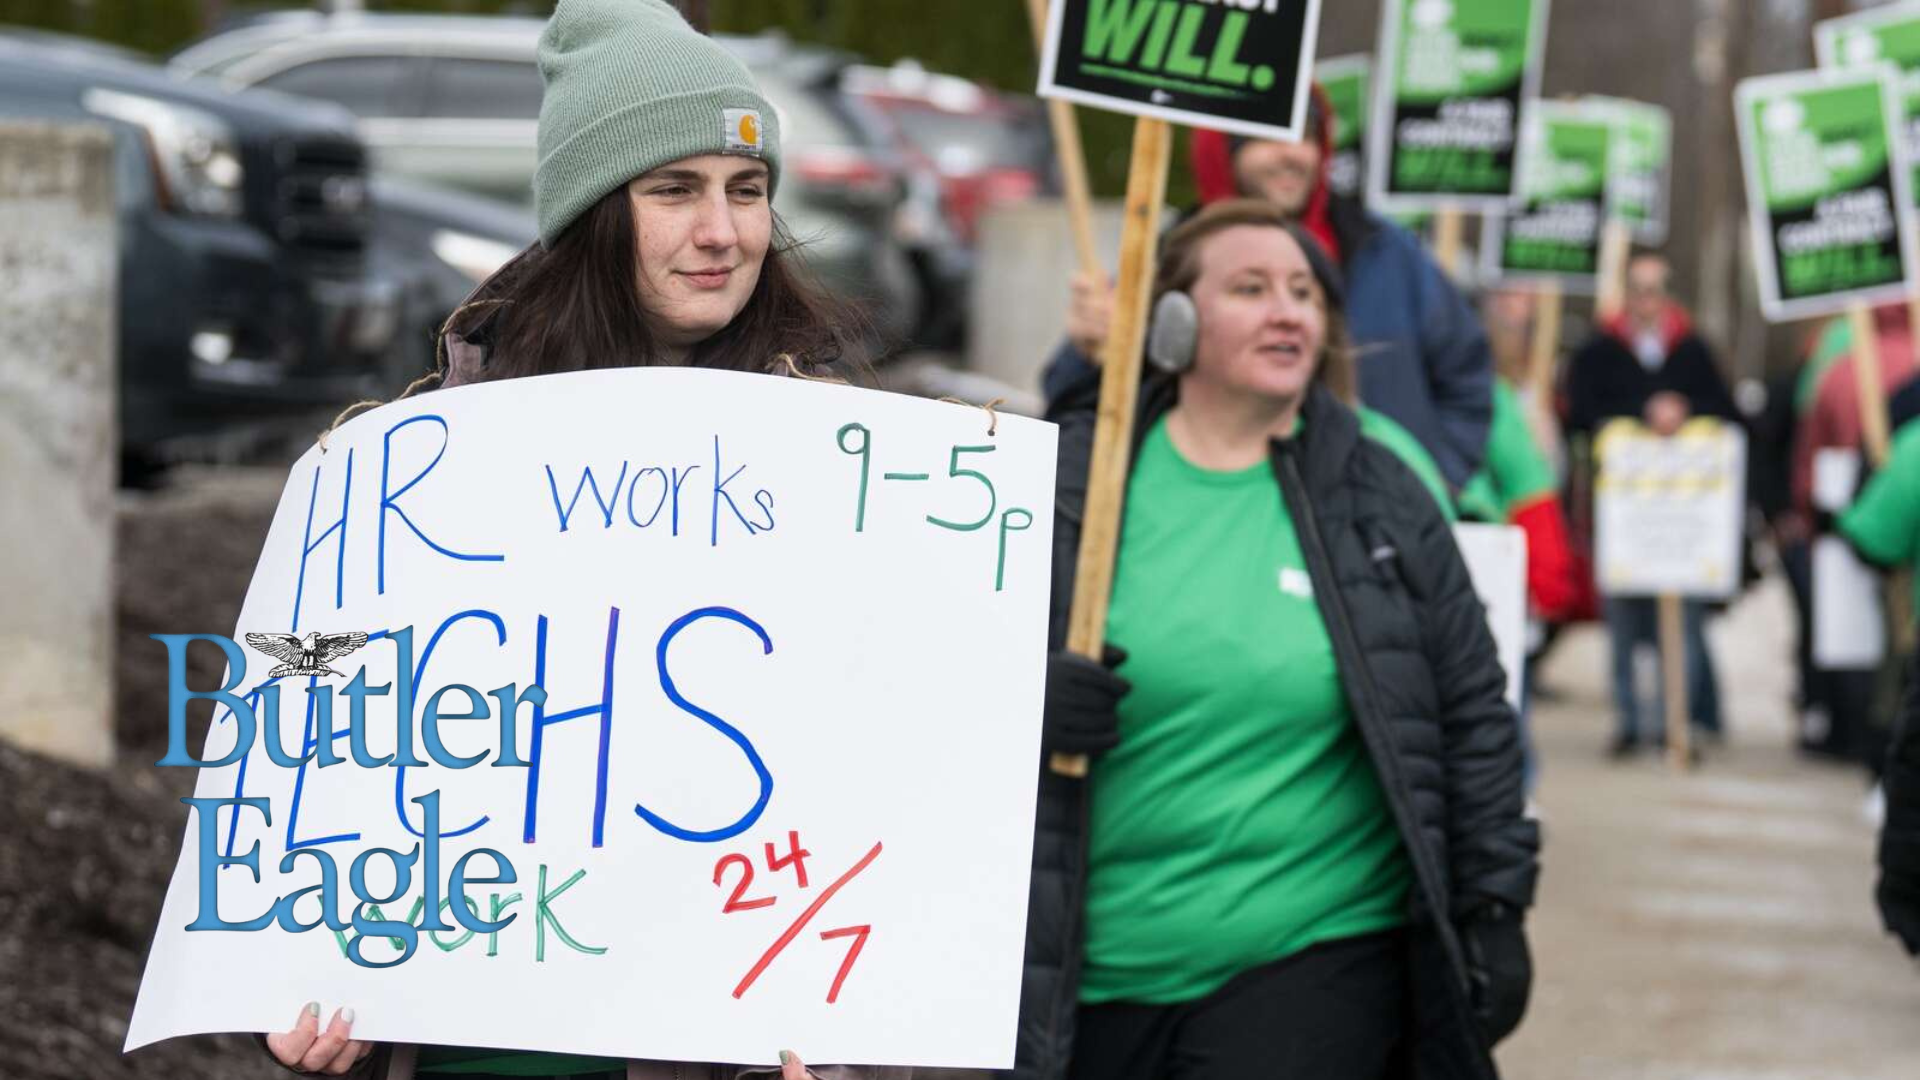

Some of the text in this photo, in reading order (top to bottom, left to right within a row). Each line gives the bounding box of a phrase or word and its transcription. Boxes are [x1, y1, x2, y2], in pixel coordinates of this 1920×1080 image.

[1082, 0, 1275, 90] WILL.
[293, 414, 504, 632] HR
[545, 434, 774, 546] works
[713, 831, 882, 1004] 24/7
